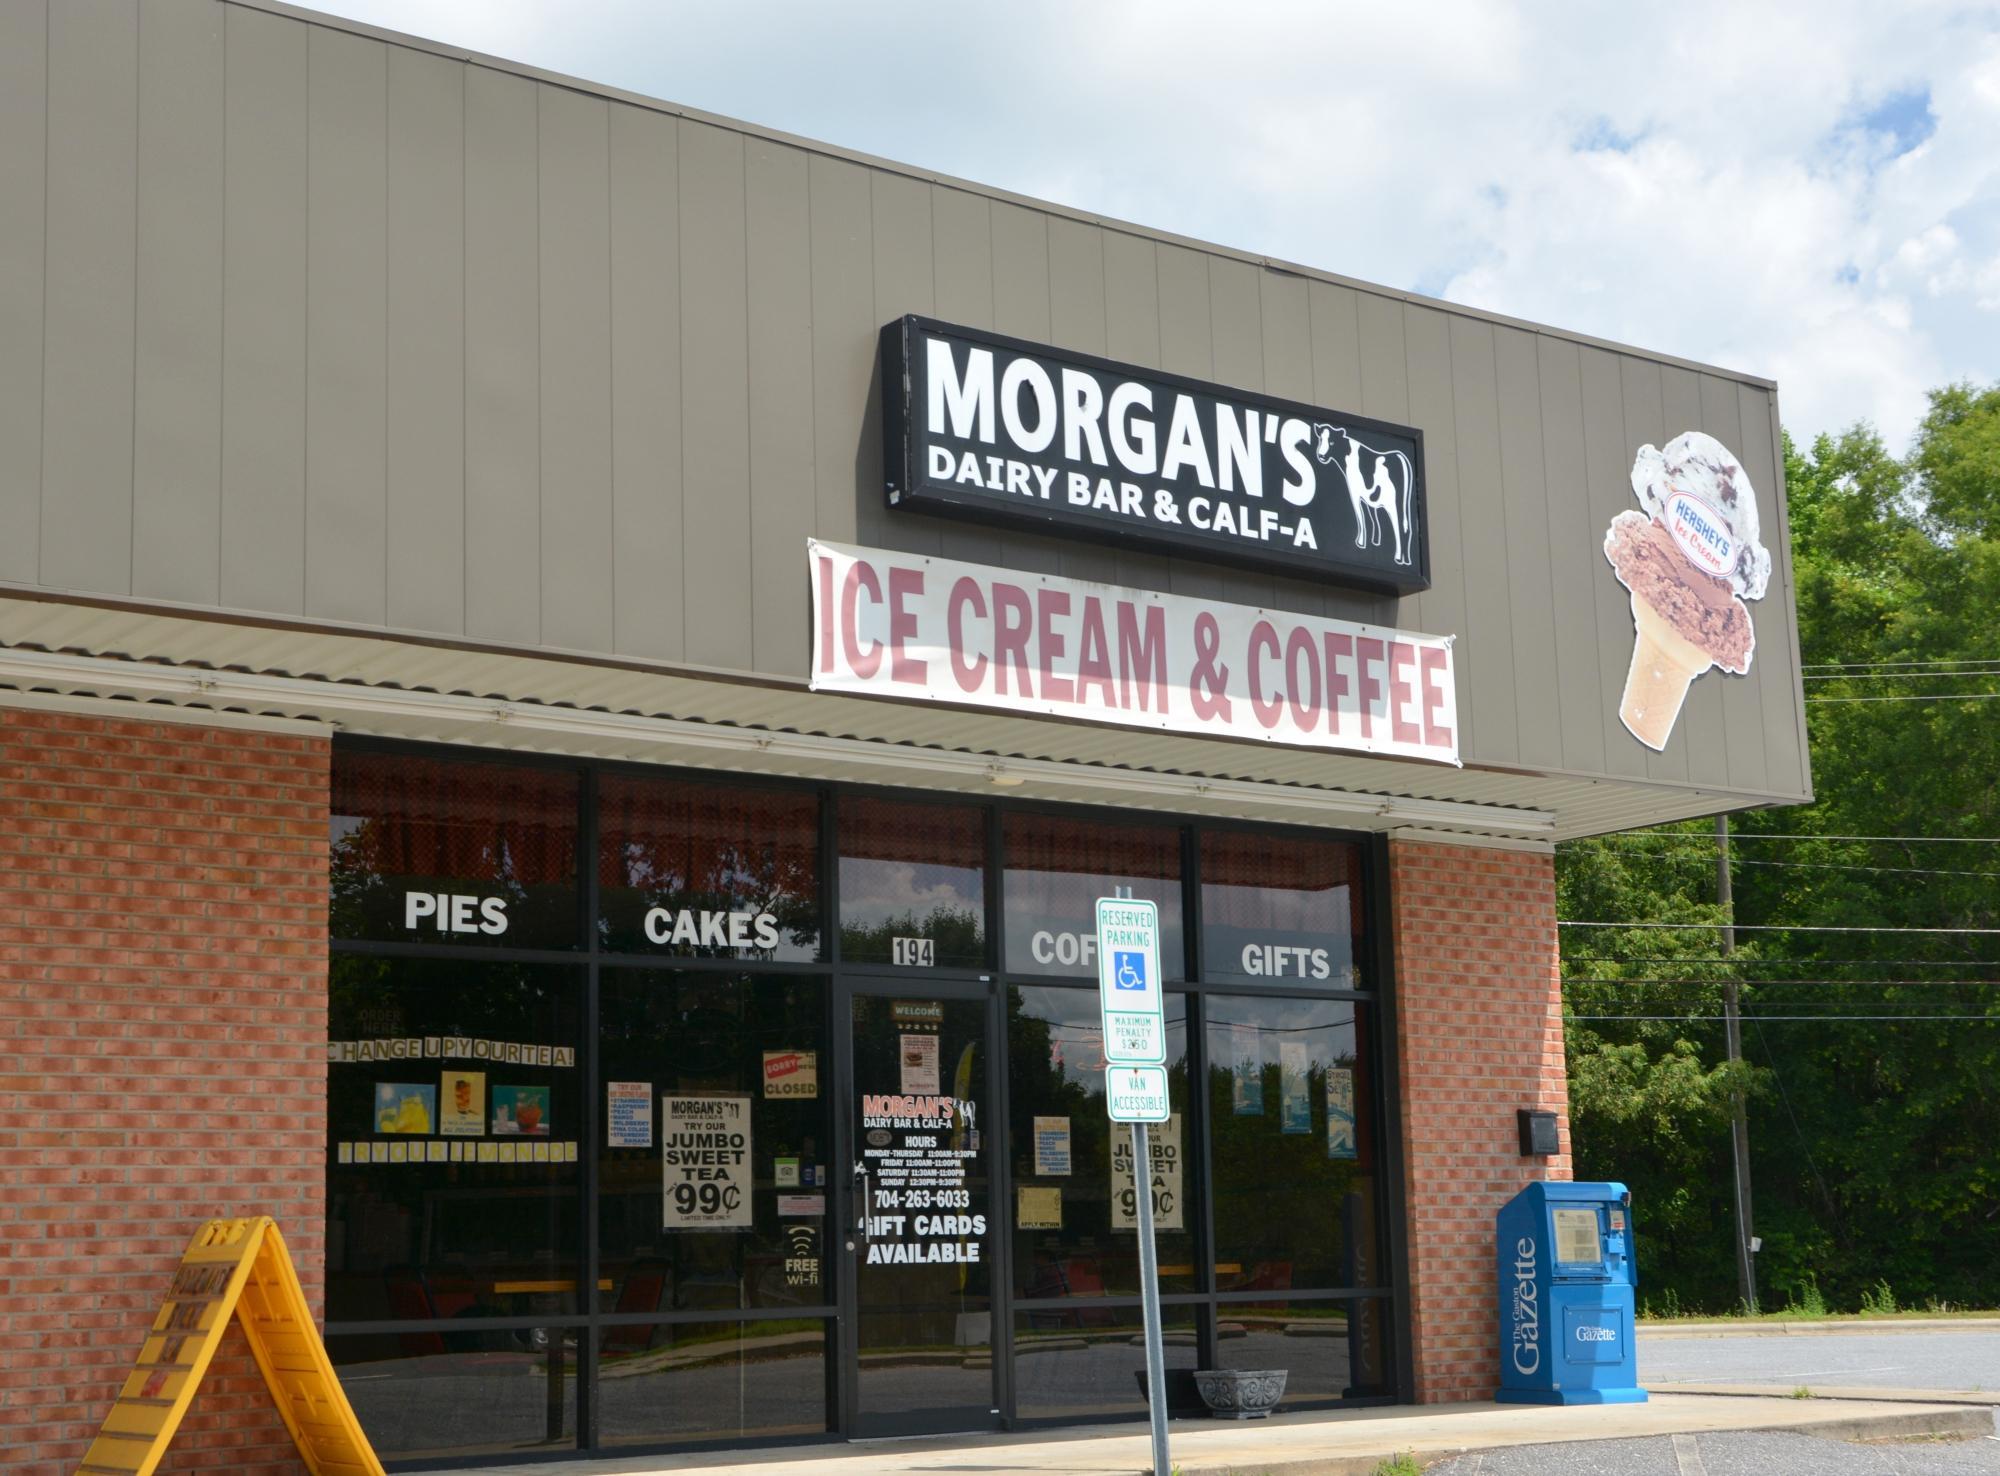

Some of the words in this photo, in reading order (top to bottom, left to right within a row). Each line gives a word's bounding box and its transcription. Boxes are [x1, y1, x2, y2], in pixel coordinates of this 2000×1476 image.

[927, 338, 1317, 506] MORGAN'S
[927, 444, 1059, 499] DAIRY
[1066, 475, 1145, 519] BAR
[1154, 490, 1183, 524] &
[1188, 496, 1318, 551] CALF-A
[1676, 499, 1730, 557] HERSHEY'S
[1674, 518, 1688, 543] Ice
[1689, 533, 1721, 571] Cream
[818, 556, 928, 686] ICE
[947, 575, 1169, 716] CREAM
[1189, 611, 1233, 724] &
[1247, 621, 1453, 749] COFFEE
[405, 890, 509, 936] PIES
[1102, 910, 1153, 928] RESERVED
[644, 906, 780, 950] CAKES
[1107, 930, 1150, 947] PARKING
[895, 938, 934, 966] 194
[1031, 930, 1097, 967] COF
[1241, 943, 1331, 980] GIFTS
[895, 1006, 941, 1016] WELCOME
[1114, 1017, 1152, 1026] MAXIMUM
[1116, 1028, 1152, 1037] PENALTY
[1121, 1039, 1148, 1050] $250
[766, 1058, 796, 1074] SORRY
[765, 1083, 817, 1095] CLOSED
[1129, 1077, 1146, 1090] VAN
[671, 1101, 723, 1114] MORGAN'S
[863, 1094, 954, 1119] MORGAN'S
[1113, 1096, 1164, 1111] ACCESSIBLE
[684, 1122, 702, 1130] TRY
[705, 1122, 726, 1130] OUR
[864, 1118, 892, 1128] DAIRY
[894, 1118, 911, 1128] BAR
[914, 1119, 921, 1128] &
[922, 1119, 952, 1129] CALF-A
[666, 1133, 744, 1148] JUMBO
[905, 1136, 937, 1147] HOURS
[666, 1150, 745, 1165] SWEET
[1113, 1144, 1176, 1158] JUBO
[681, 1168, 730, 1180] TEA
[1126, 1174, 1165, 1187] TA
[675, 1182, 741, 1214] 99¢
[874, 1190, 970, 1208] 704-263-6033
[915, 1215, 986, 1236] CARDS
[867, 1243, 980, 1264] AVAILABLE
[785, 1259, 819, 1272] FREE
[787, 1272, 818, 1285] wi-fi
[1514, 1237, 1540, 1376] Gazette
[1576, 1326, 1616, 1342] Gazette
